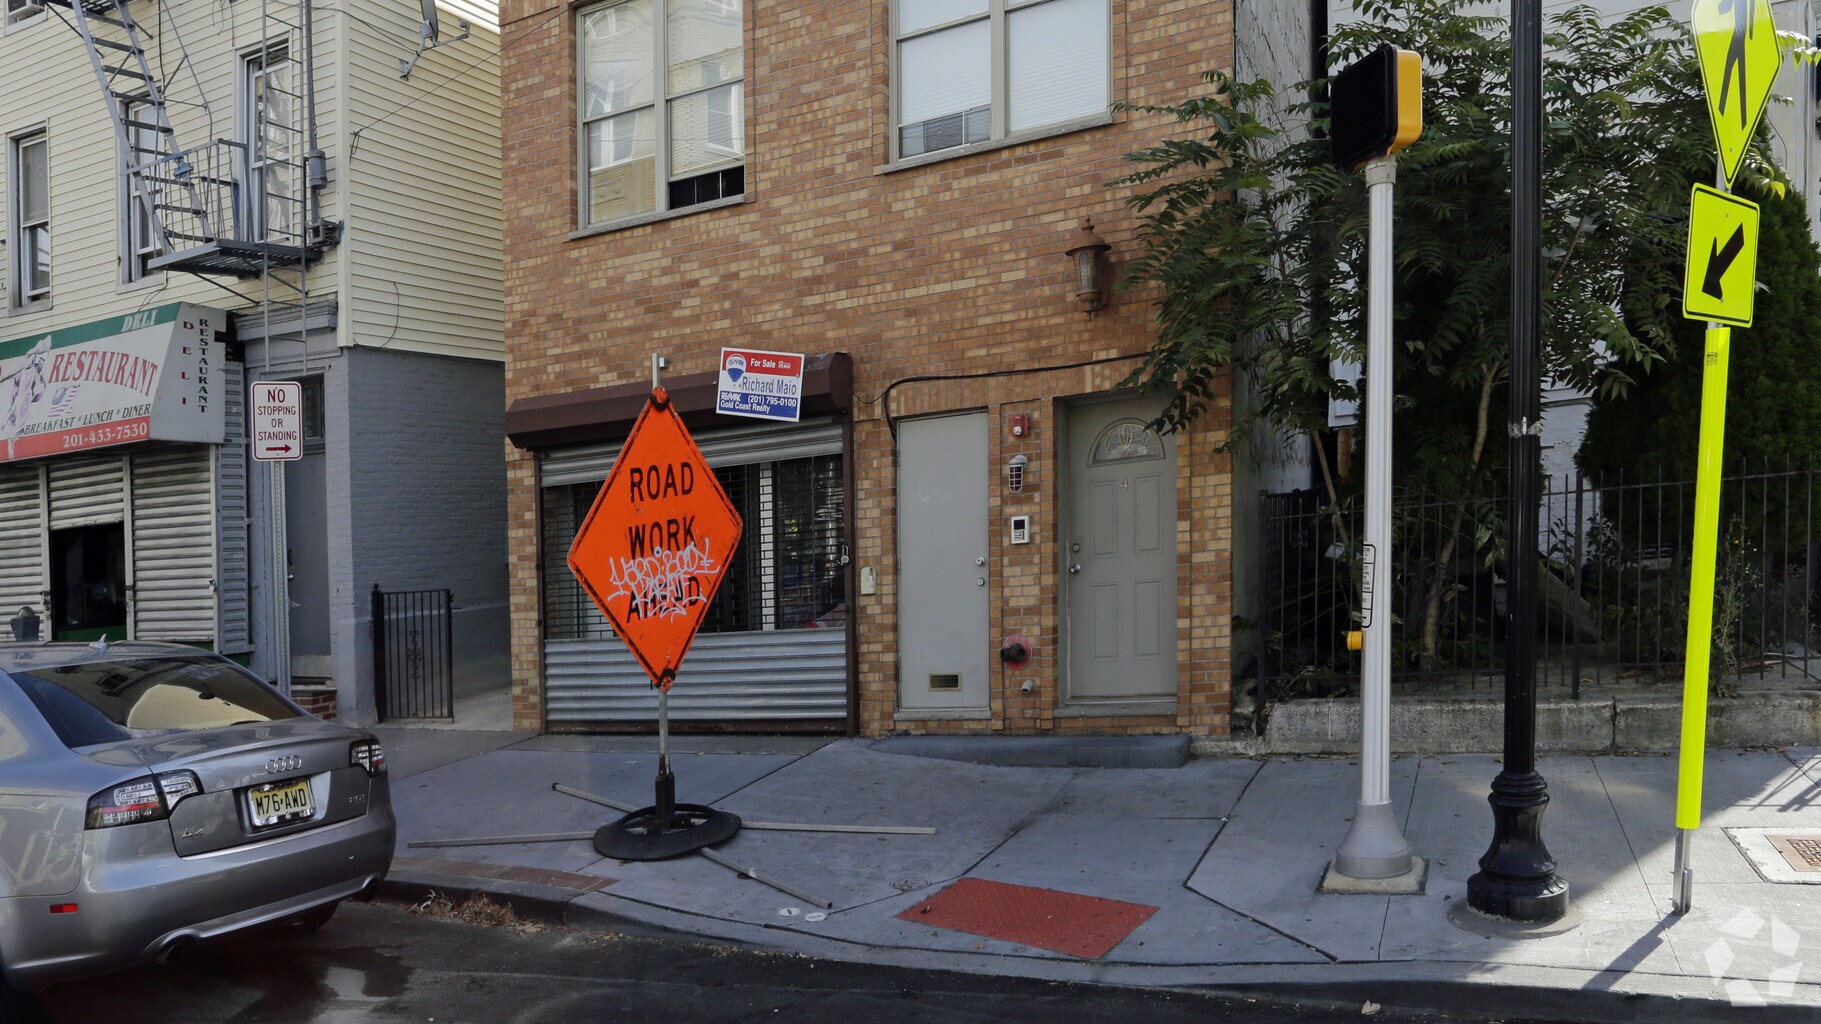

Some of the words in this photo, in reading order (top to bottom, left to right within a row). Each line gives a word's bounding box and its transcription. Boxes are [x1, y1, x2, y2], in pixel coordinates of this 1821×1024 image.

[121, 309, 159, 333] DELI
[181, 321, 195, 405] DELI
[198, 318, 209, 413] RESTAURANT
[750, 358, 761, 367] For
[762, 359, 776, 368] Sale
[48, 350, 158, 397] RESTAURANT
[267, 388, 286, 403] NO
[742, 376, 774, 393] Richard
[776, 379, 797, 396] Maio
[257, 405, 297, 416] STOPPING
[720, 400, 734, 409] Gold
[735, 401, 751, 411] Coast
[752, 404, 770, 414] Realty
[748, 395, 765, 405] (201)
[766, 397, 797, 407] 795-0100
[24, 417, 75, 435] BREAKFAST
[83, 409, 114, 425] LUNCH
[122, 403, 151, 418] DINER
[271, 418, 284, 428] OR
[63, 422, 148, 448] 201-433-7530
[258, 430, 297, 441] STANDING
[630, 461, 695, 503] ROAD
[1119, 478, 1130, 493] 4
[628, 514, 696, 560] WORK
